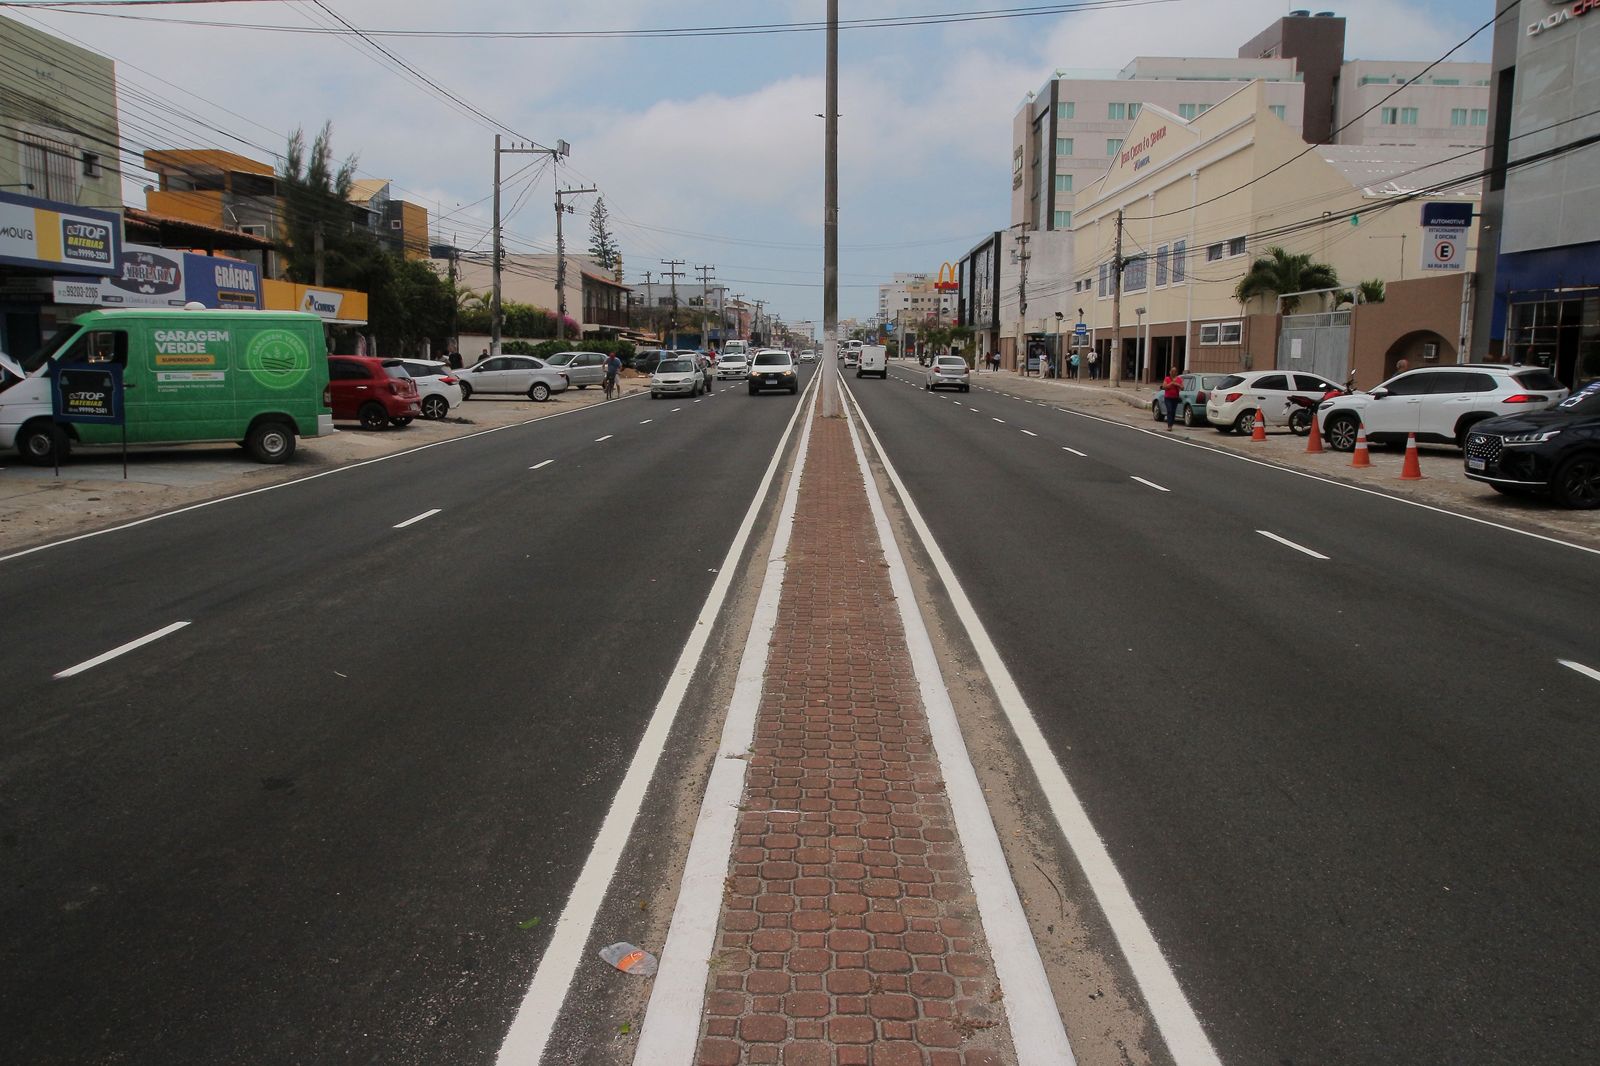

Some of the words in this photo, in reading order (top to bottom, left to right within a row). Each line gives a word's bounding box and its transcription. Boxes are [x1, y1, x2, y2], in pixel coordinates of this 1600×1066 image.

[78, 224, 107, 240] TOP
[68, 236, 105, 250] BATERIAS
[1440, 245, 1449, 258] E
[215, 264, 256, 291] GRÁFICA
[154, 330, 229, 342] GARAGEM
[155, 342, 207, 354] VERDE
[79, 391, 105, 400] TOP
[69, 399, 103, 407] BATERIAS
